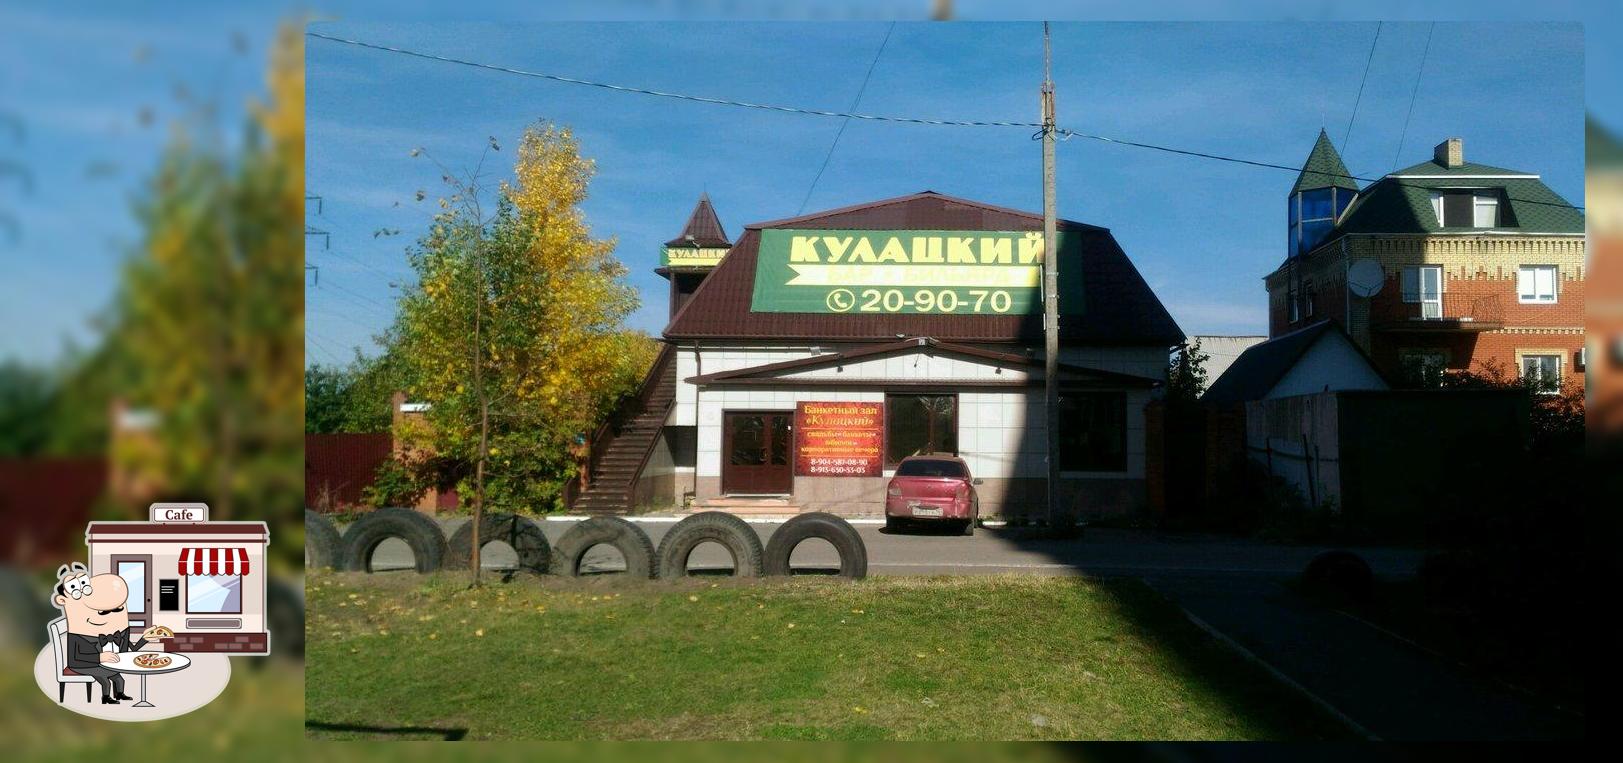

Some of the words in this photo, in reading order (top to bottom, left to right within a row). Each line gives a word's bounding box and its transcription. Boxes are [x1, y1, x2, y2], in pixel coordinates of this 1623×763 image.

[668, 248, 730, 258] КУЛАЦКИ
[790, 232, 1044, 264] КУЛАЦКИЙ
[860, 289, 1012, 313] 20-90-70
[804, 405, 858, 415] Банкетный
[859, 407, 877, 415] зал
